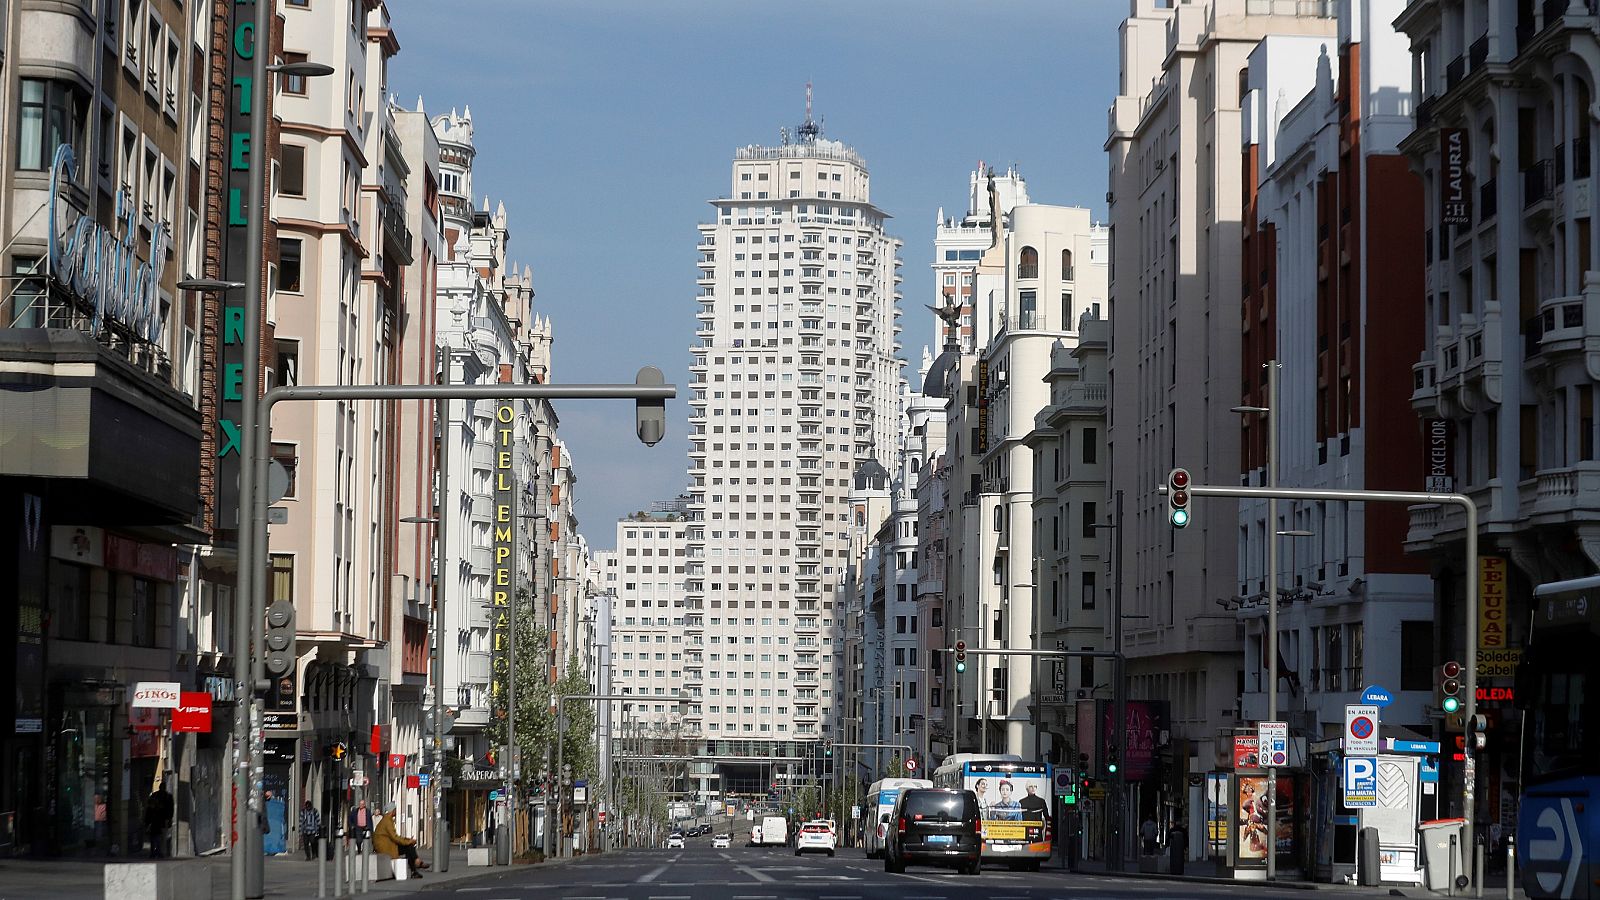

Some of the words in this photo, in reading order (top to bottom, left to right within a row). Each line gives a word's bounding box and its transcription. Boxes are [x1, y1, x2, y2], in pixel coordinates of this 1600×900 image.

[230, 0, 256, 226] OTEL
[1449, 131, 1462, 201] LAURIA
[217, 306, 245, 459] REX
[496, 398, 514, 491] OTEL
[979, 407, 988, 450] BESAYA
[1431, 421, 1447, 475] EXCELSIOR
[1483, 558, 1504, 646] PELUCAS
[1476, 650, 1521, 662] Soleda
[1477, 663, 1517, 675] Cabell
[135, 690, 177, 700] GINOS
[176, 706, 209, 714] VIPS
[1476, 688, 1513, 700] OLEDA
[1347, 759, 1374, 790] P
